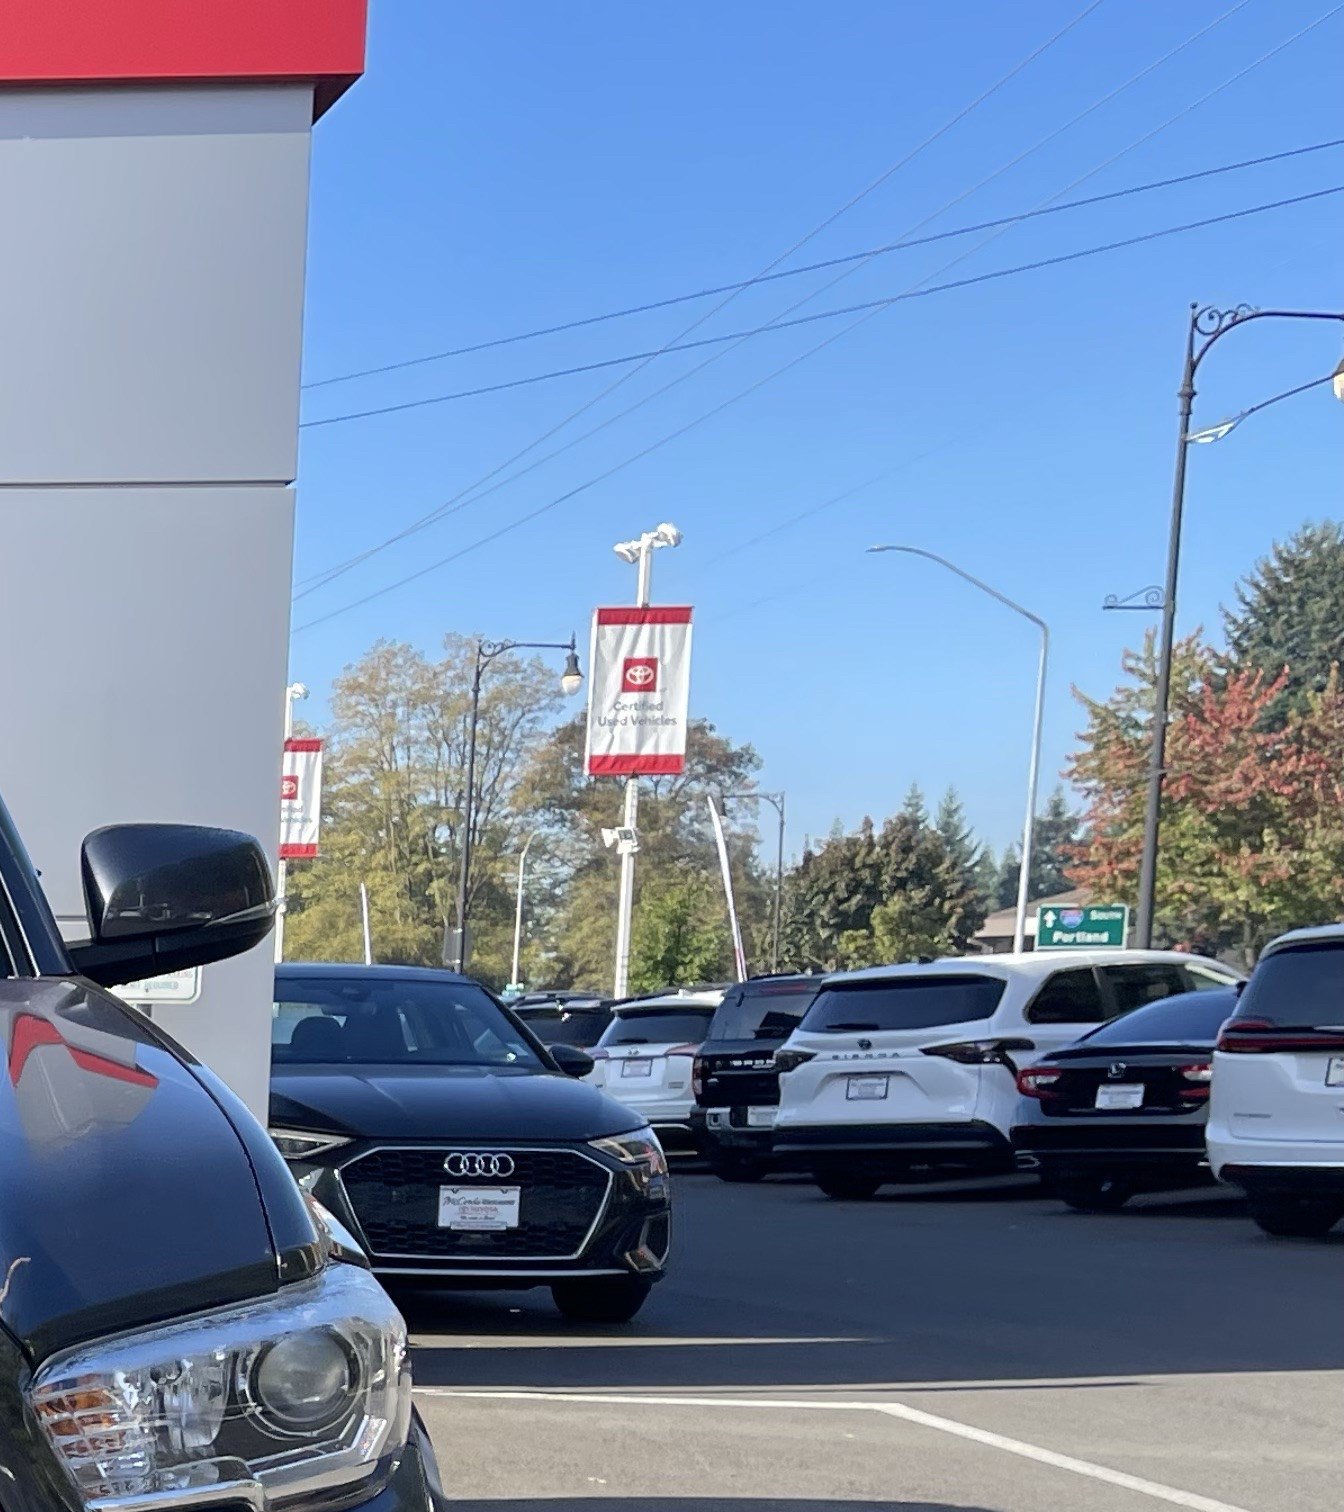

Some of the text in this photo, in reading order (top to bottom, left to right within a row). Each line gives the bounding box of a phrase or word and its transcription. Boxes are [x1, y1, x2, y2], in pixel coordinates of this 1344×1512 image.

[613, 701, 664, 711] Certified
[598, 715, 678, 727] Used Vehicles
[1053, 930, 1110, 944] Portland
